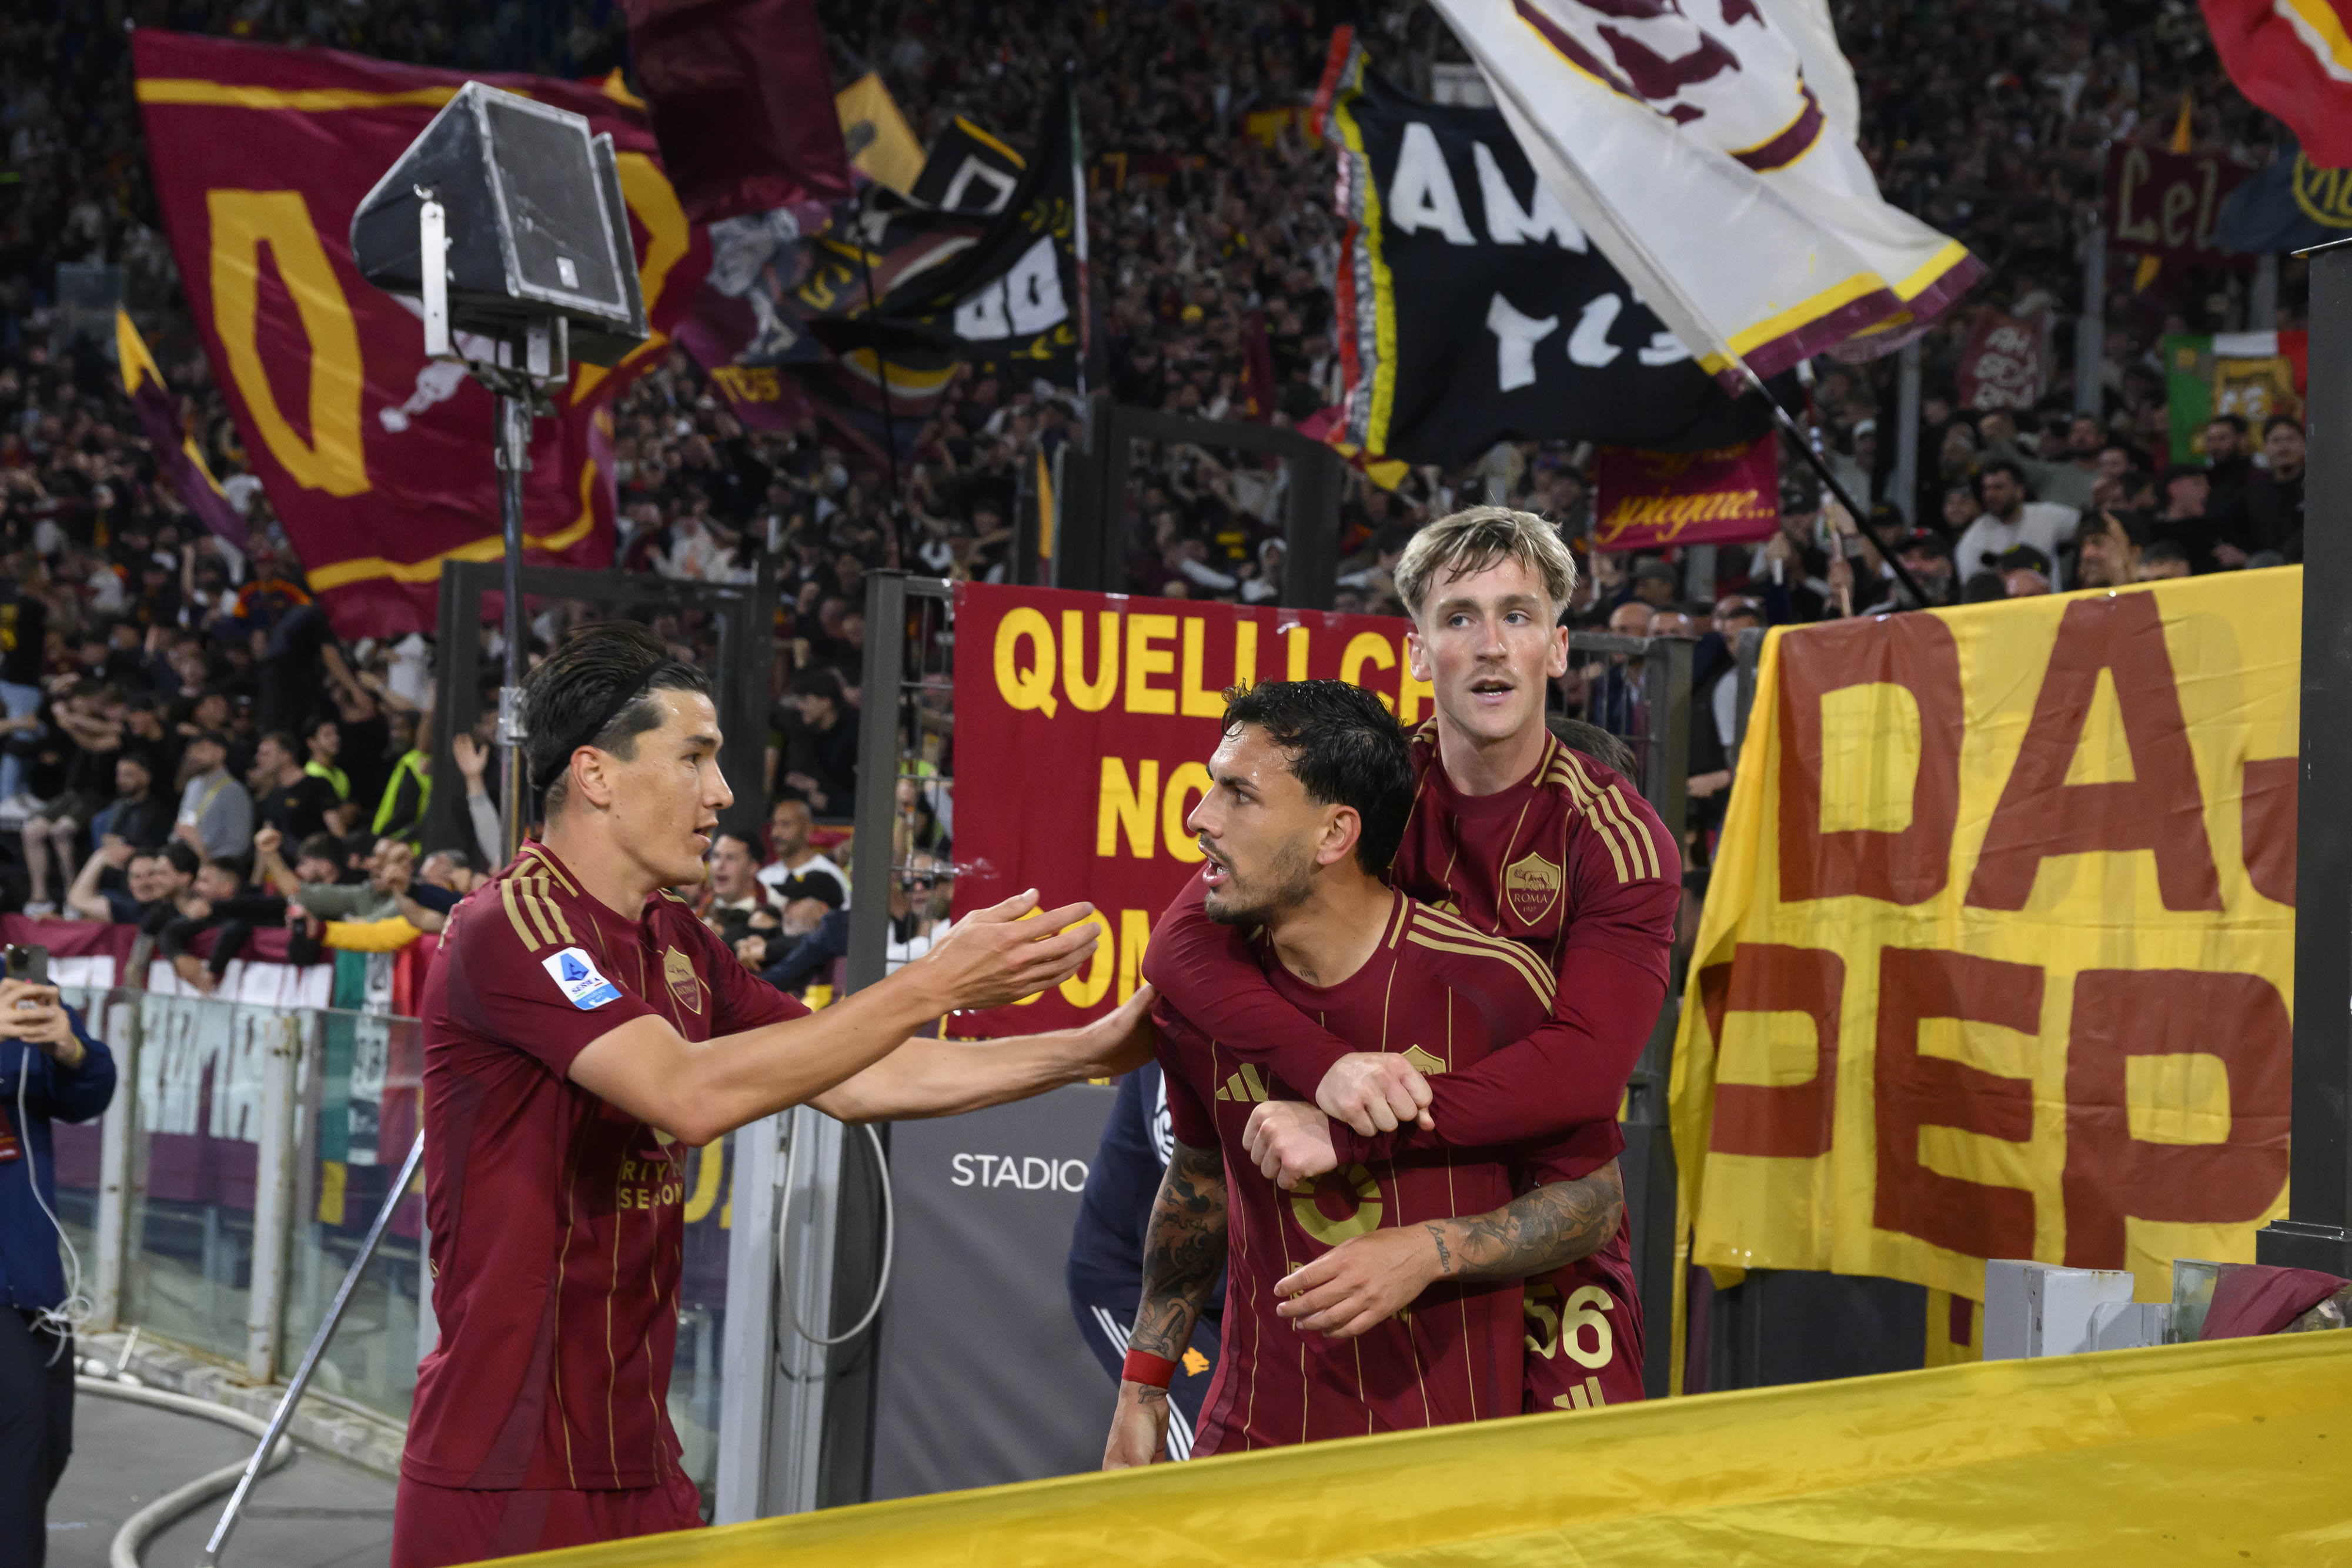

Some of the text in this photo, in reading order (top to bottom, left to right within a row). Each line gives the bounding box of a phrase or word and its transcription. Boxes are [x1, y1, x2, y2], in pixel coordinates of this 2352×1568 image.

[1514, 893, 1548, 903] ROMA
[950, 1152, 1090, 1193] STADIO
[1523, 1283, 1615, 1370] 56
